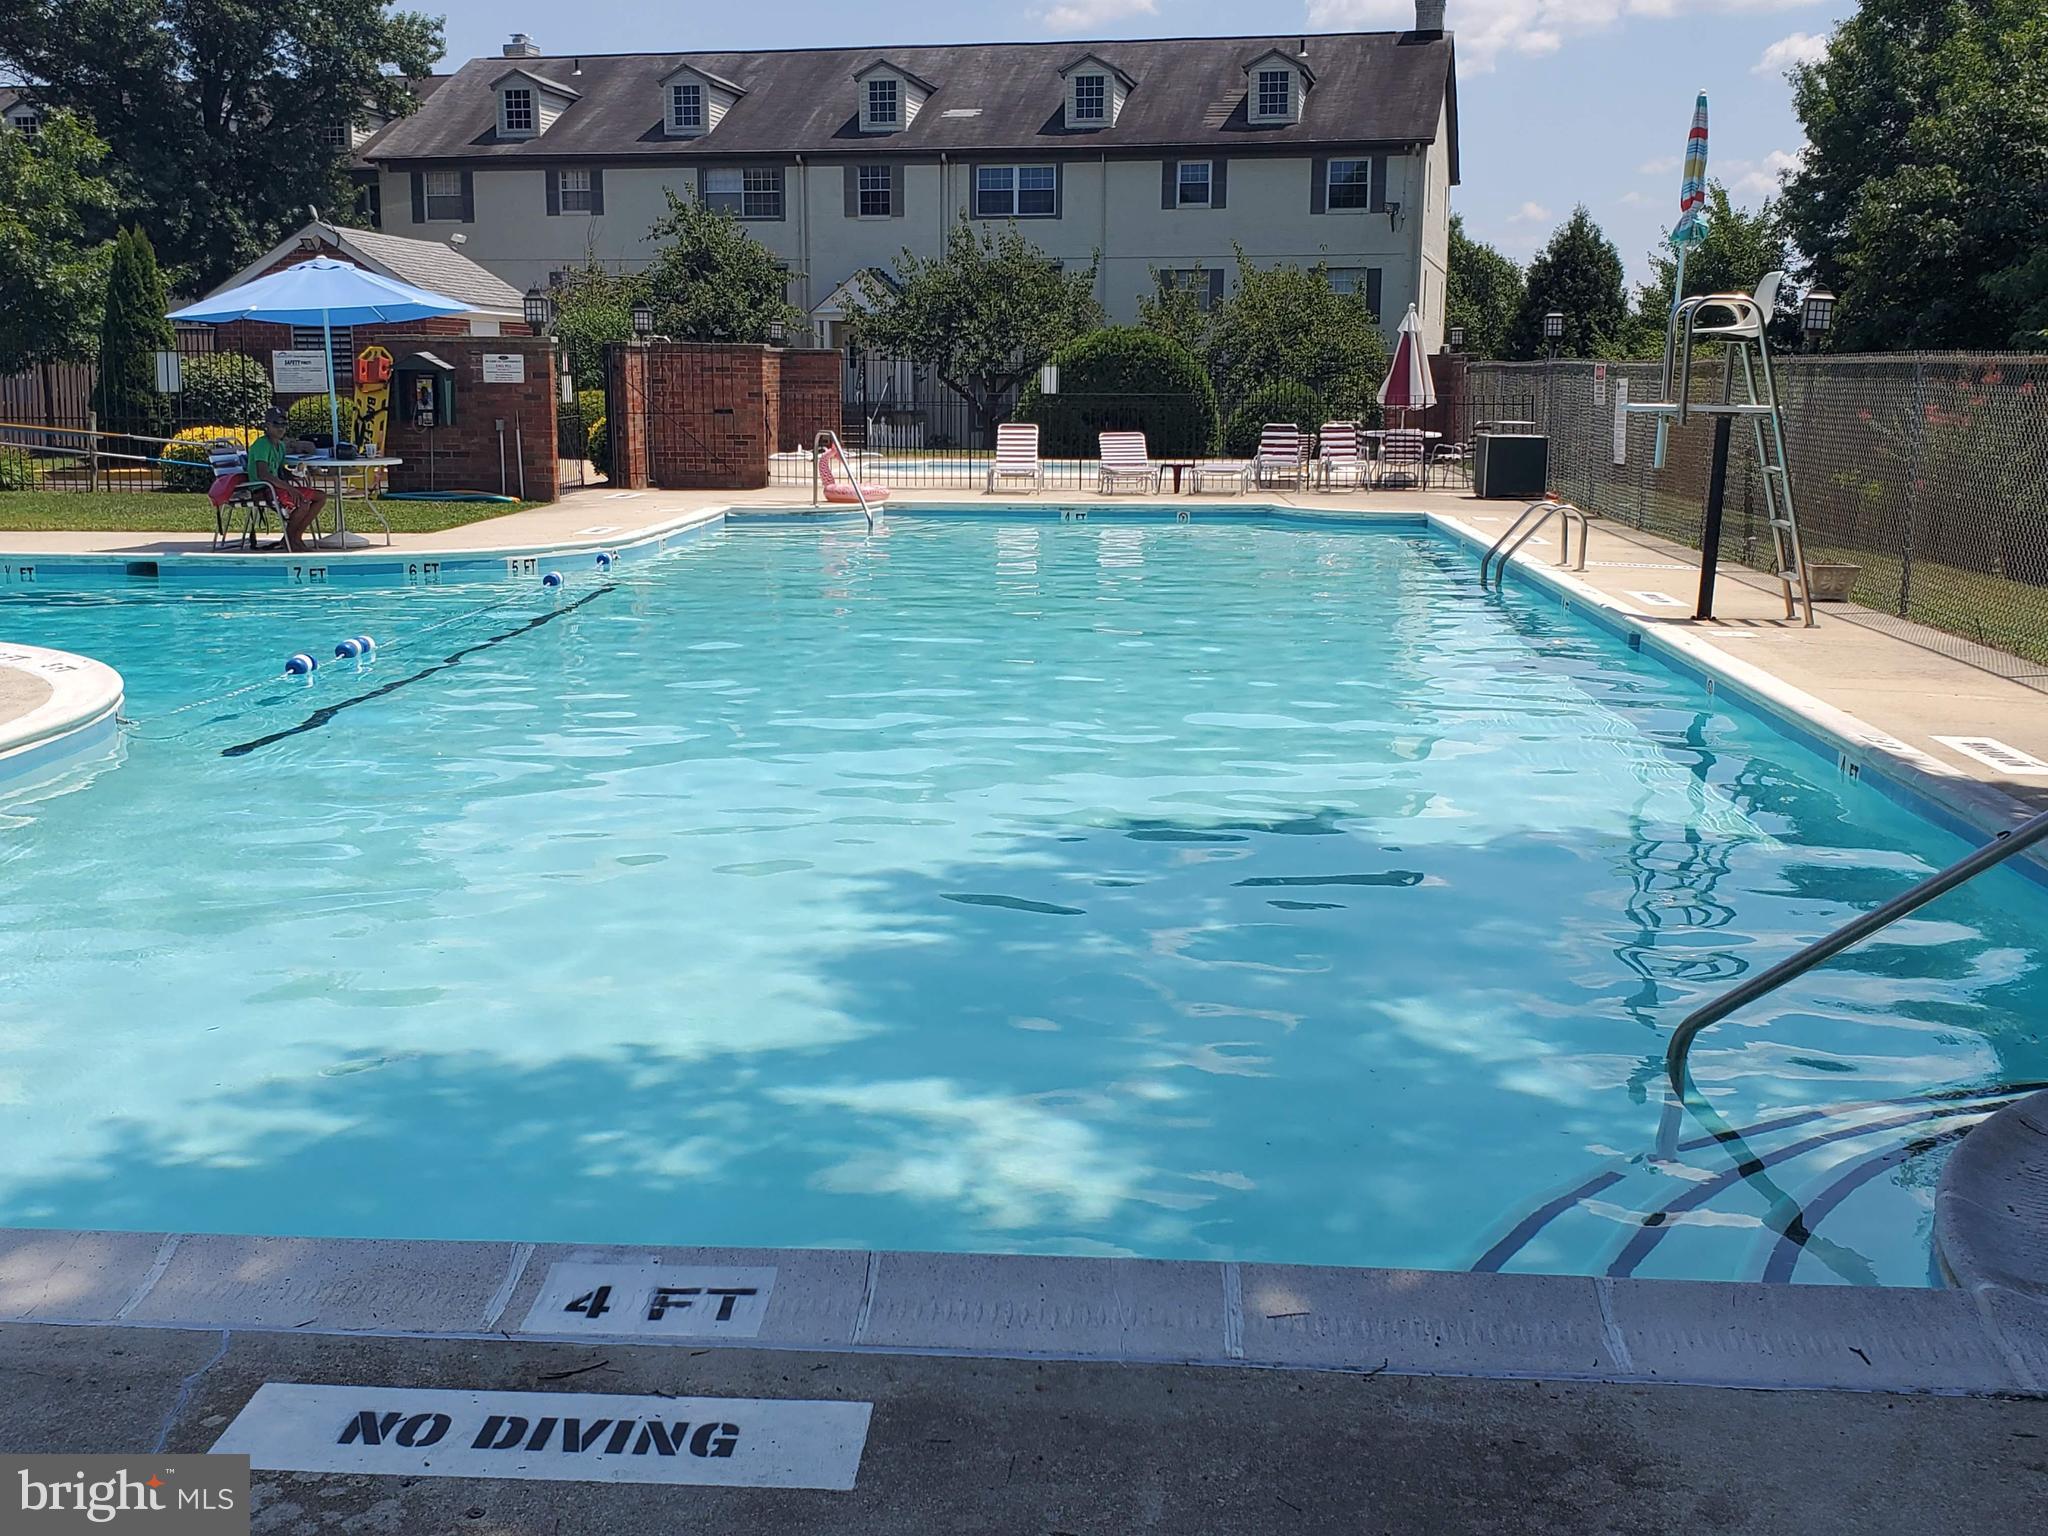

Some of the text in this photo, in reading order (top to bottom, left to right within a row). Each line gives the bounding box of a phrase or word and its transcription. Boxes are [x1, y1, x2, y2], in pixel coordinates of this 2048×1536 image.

[423, 563, 440, 577] FT
[511, 559, 537, 575] 5 FT
[564, 1285, 758, 1321] 4 FT
[337, 1411, 740, 1458] NO DIVING
